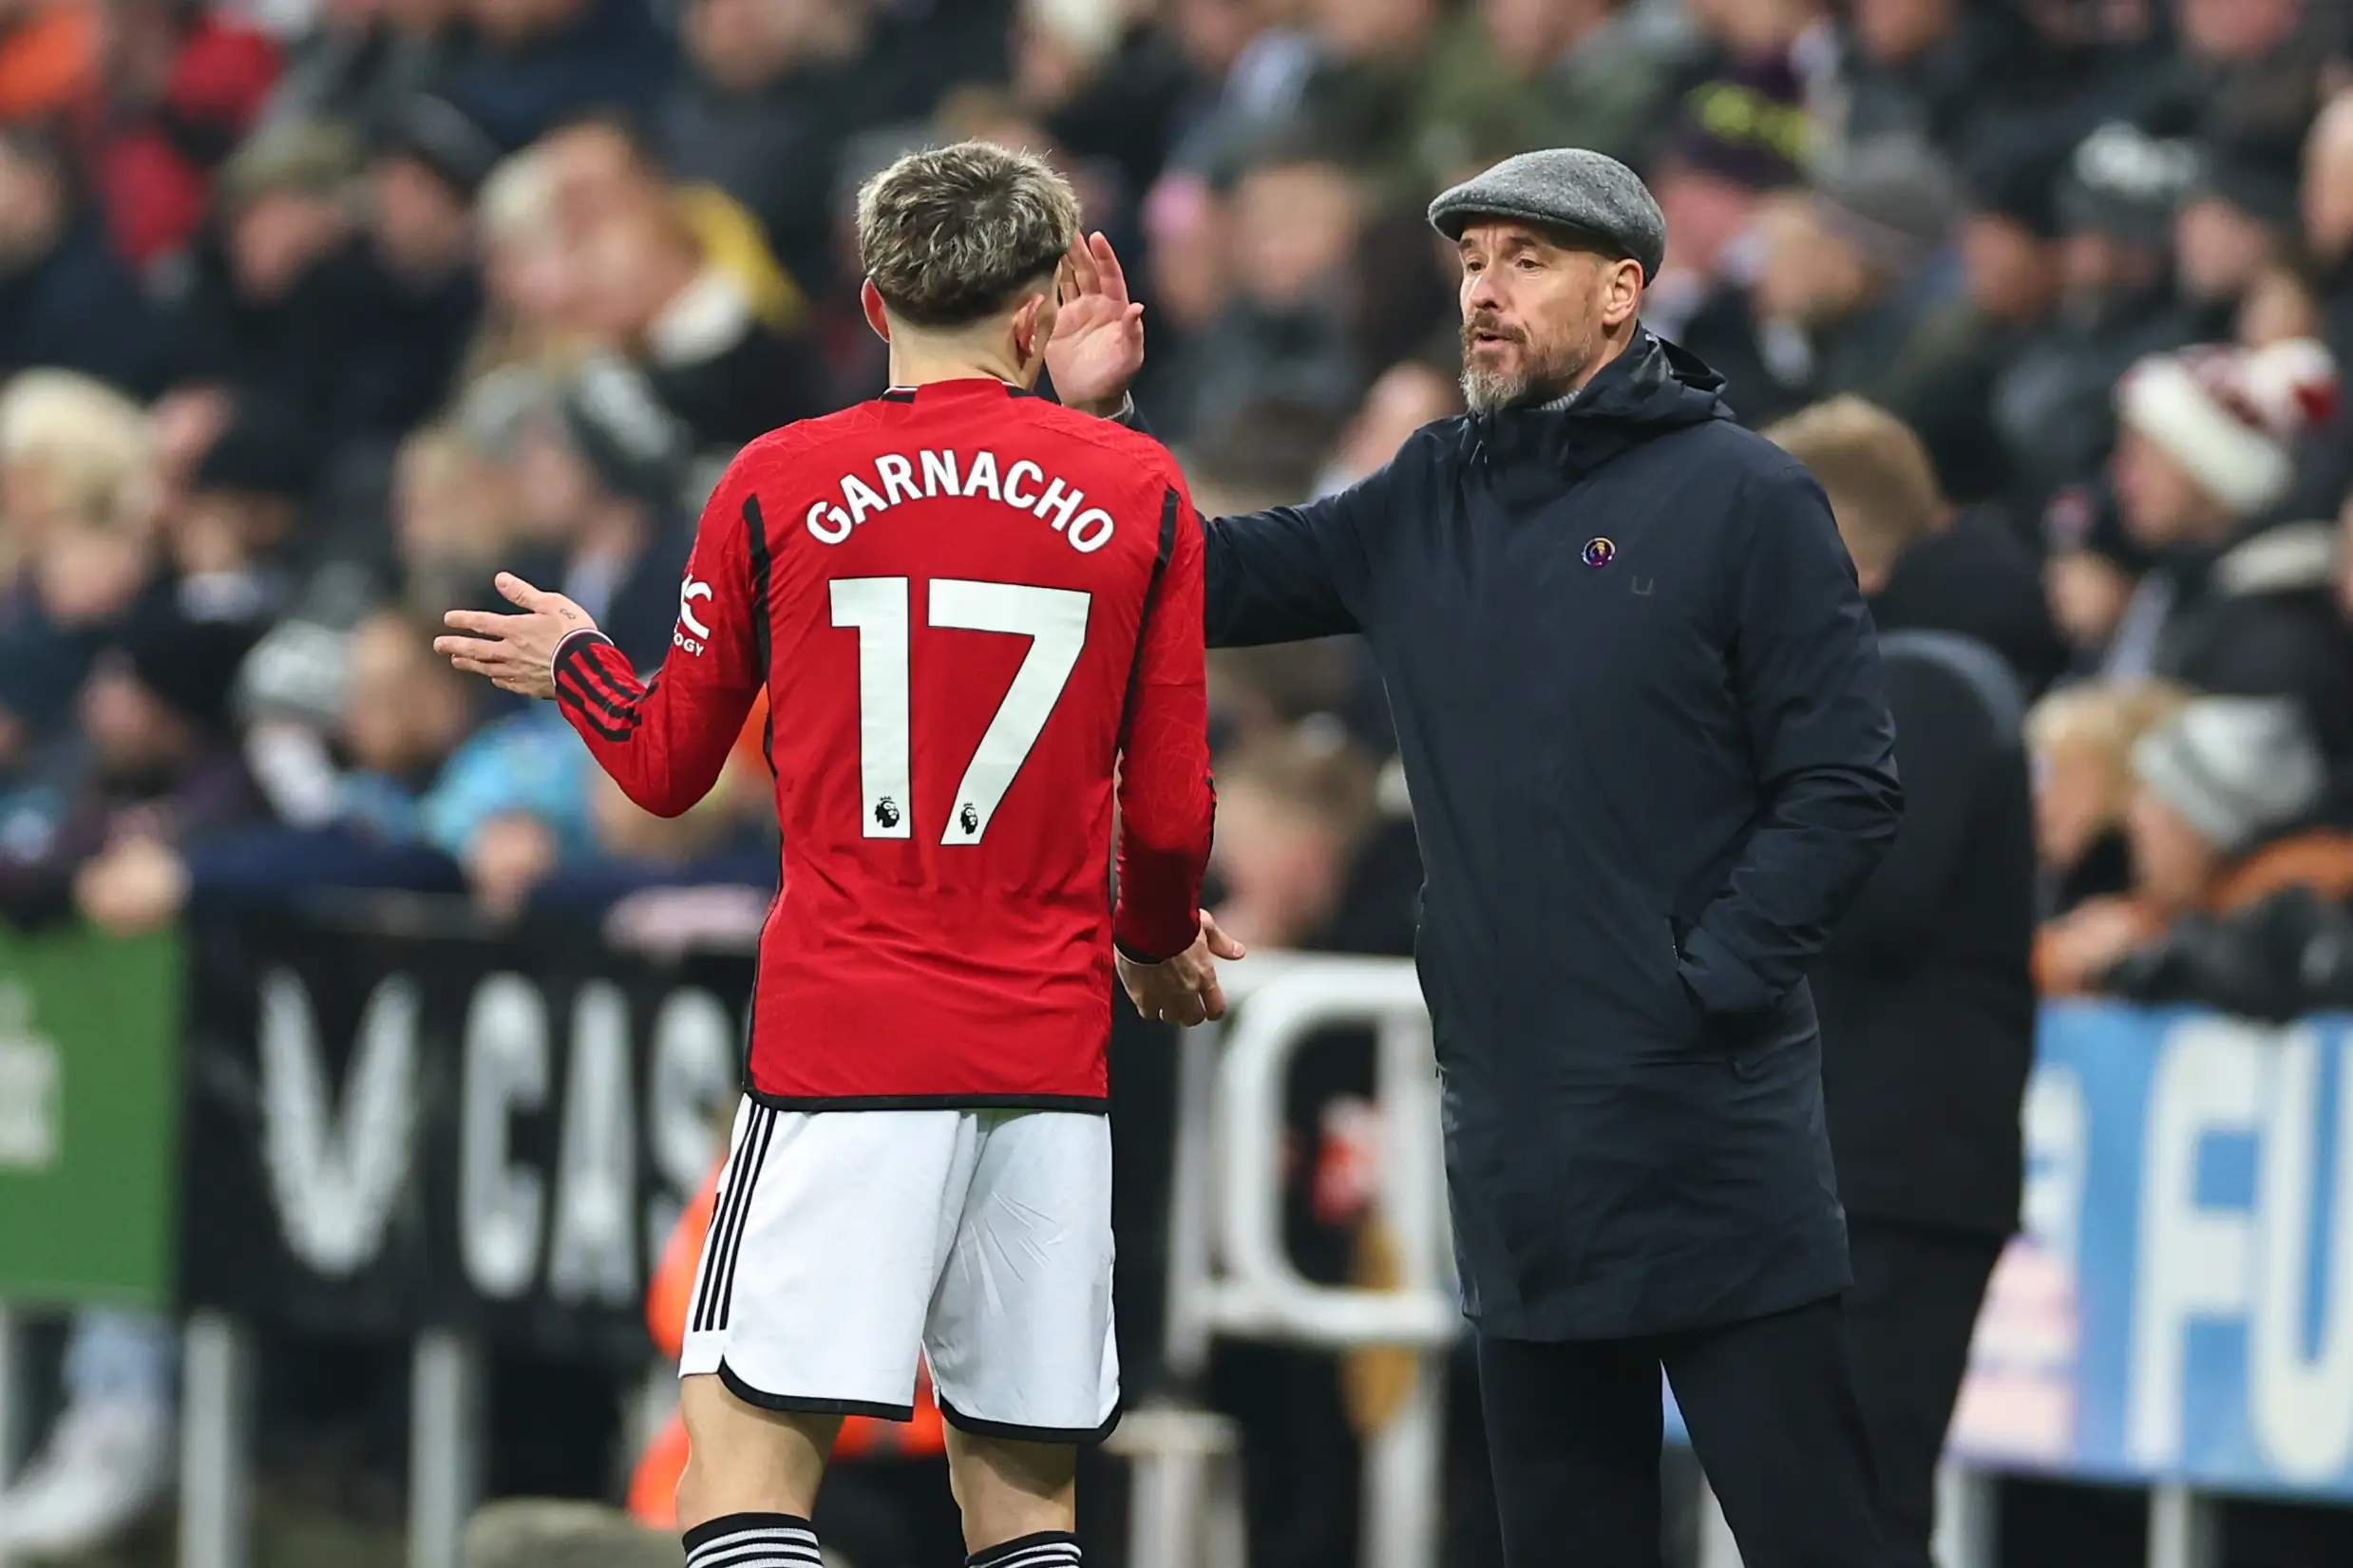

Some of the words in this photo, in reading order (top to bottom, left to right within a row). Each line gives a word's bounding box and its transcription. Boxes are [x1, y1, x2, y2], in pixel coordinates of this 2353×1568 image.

[806, 449, 1115, 554] GARNACHO
[673, 632, 704, 657] OGY
[828, 576, 1091, 846] 17
